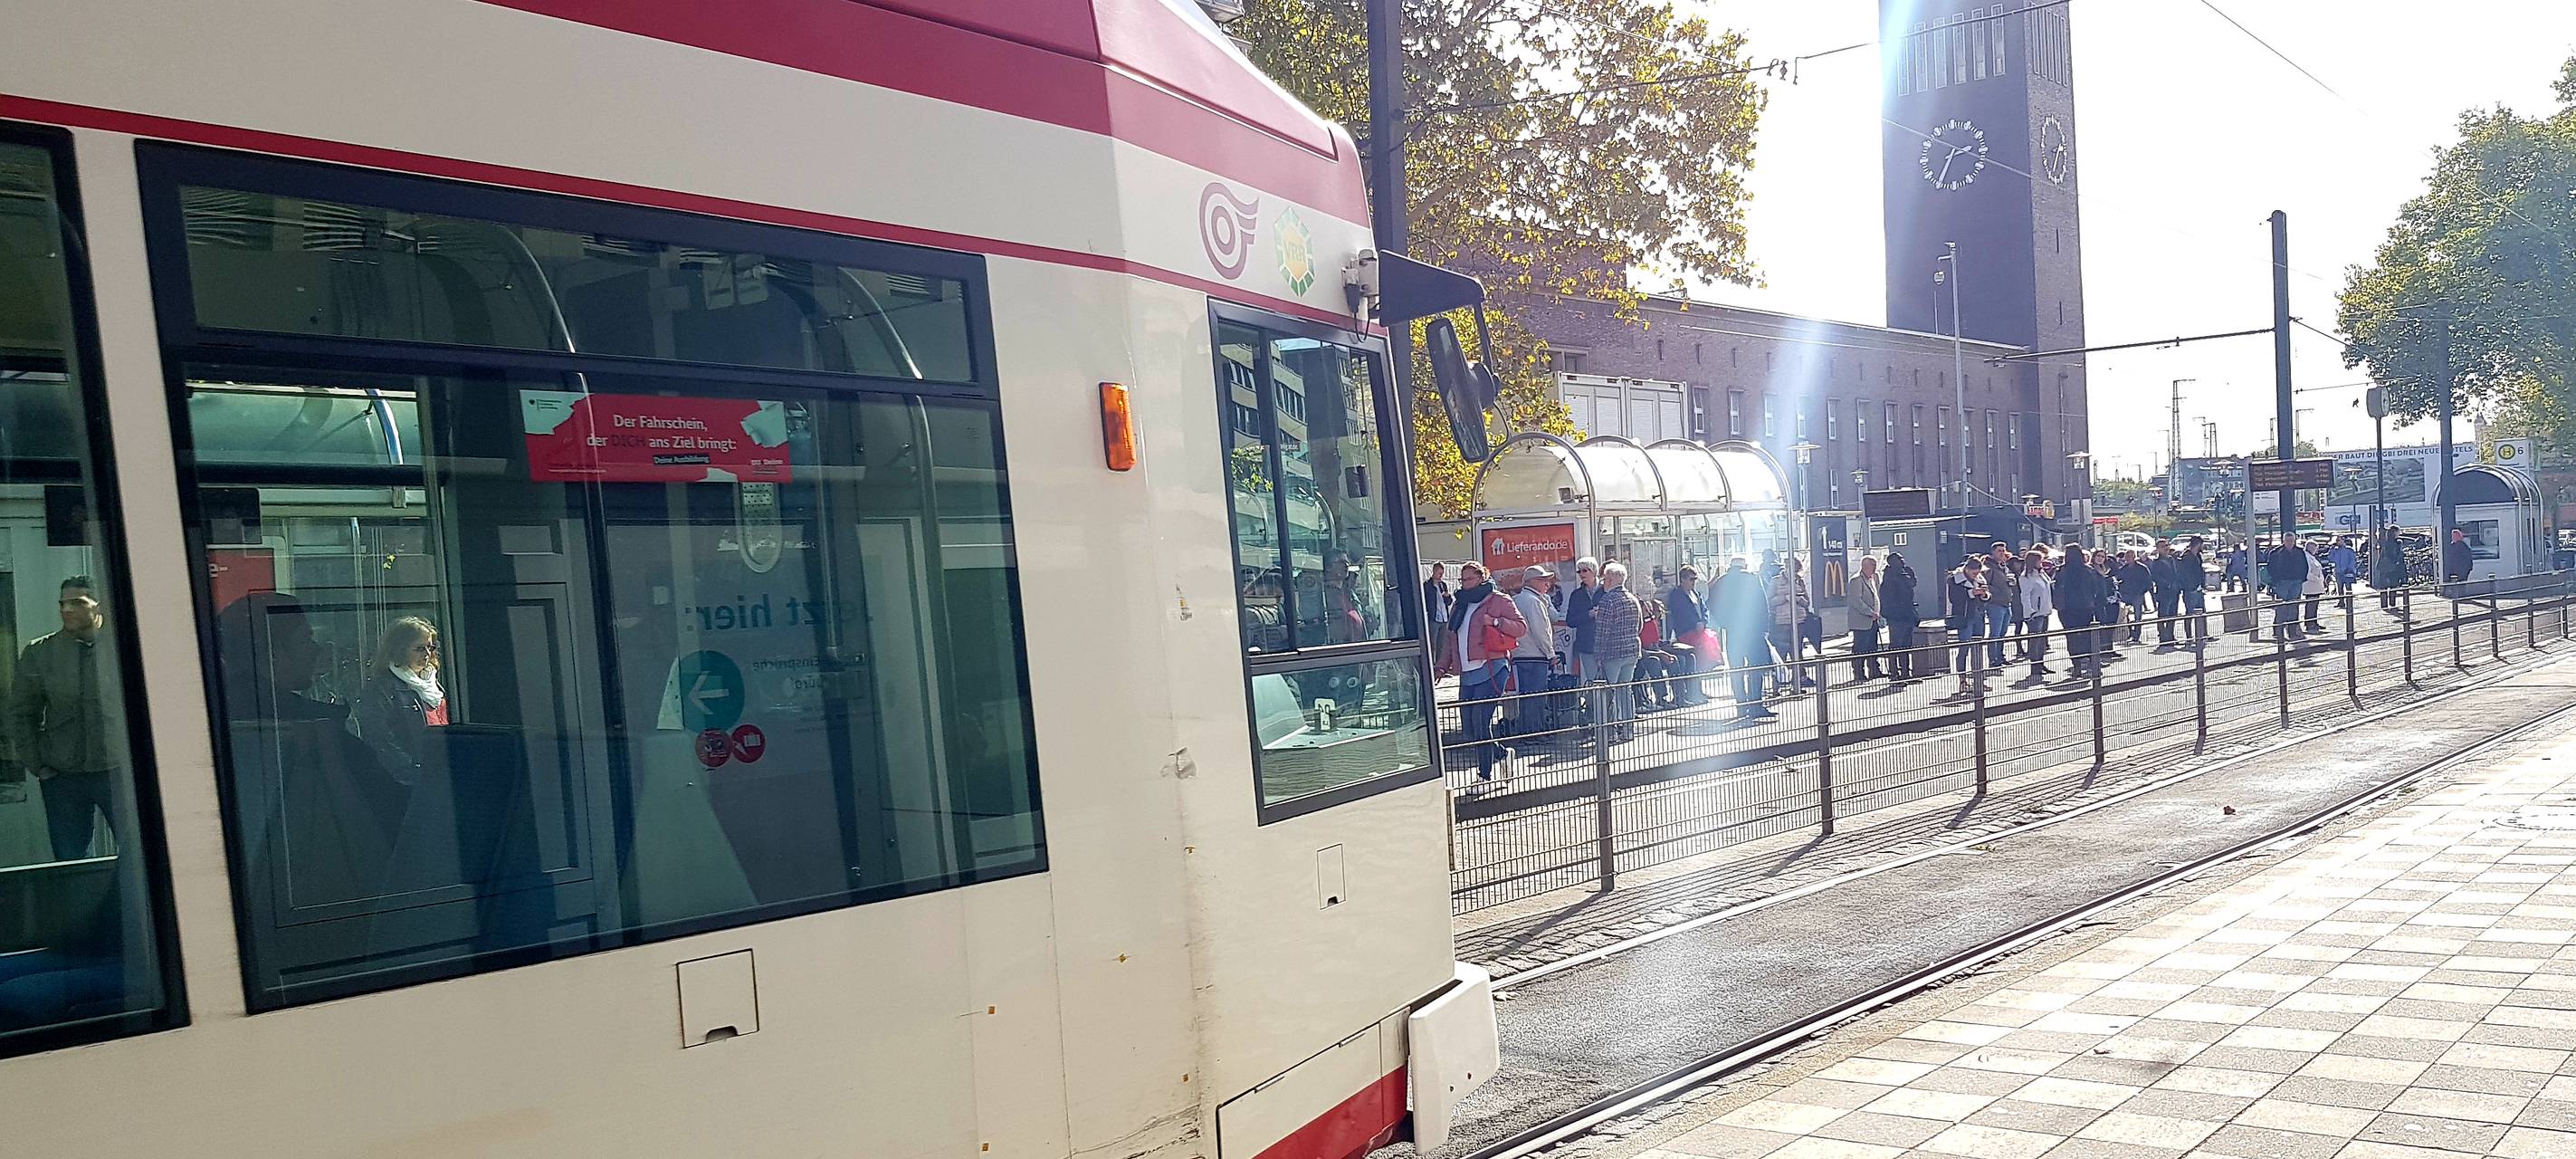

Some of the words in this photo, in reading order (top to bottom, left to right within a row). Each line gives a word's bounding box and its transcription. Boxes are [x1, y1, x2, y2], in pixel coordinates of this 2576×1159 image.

[613, 415, 636, 427] Der
[639, 416, 708, 431] Fahrschein,
[587, 433, 608, 446] der
[649, 437, 670, 448] ans
[672, 436, 695, 449] Ziel
[2517, 446, 2524, 455] 6
[1506, 541, 1568, 552] Lieferando.de
